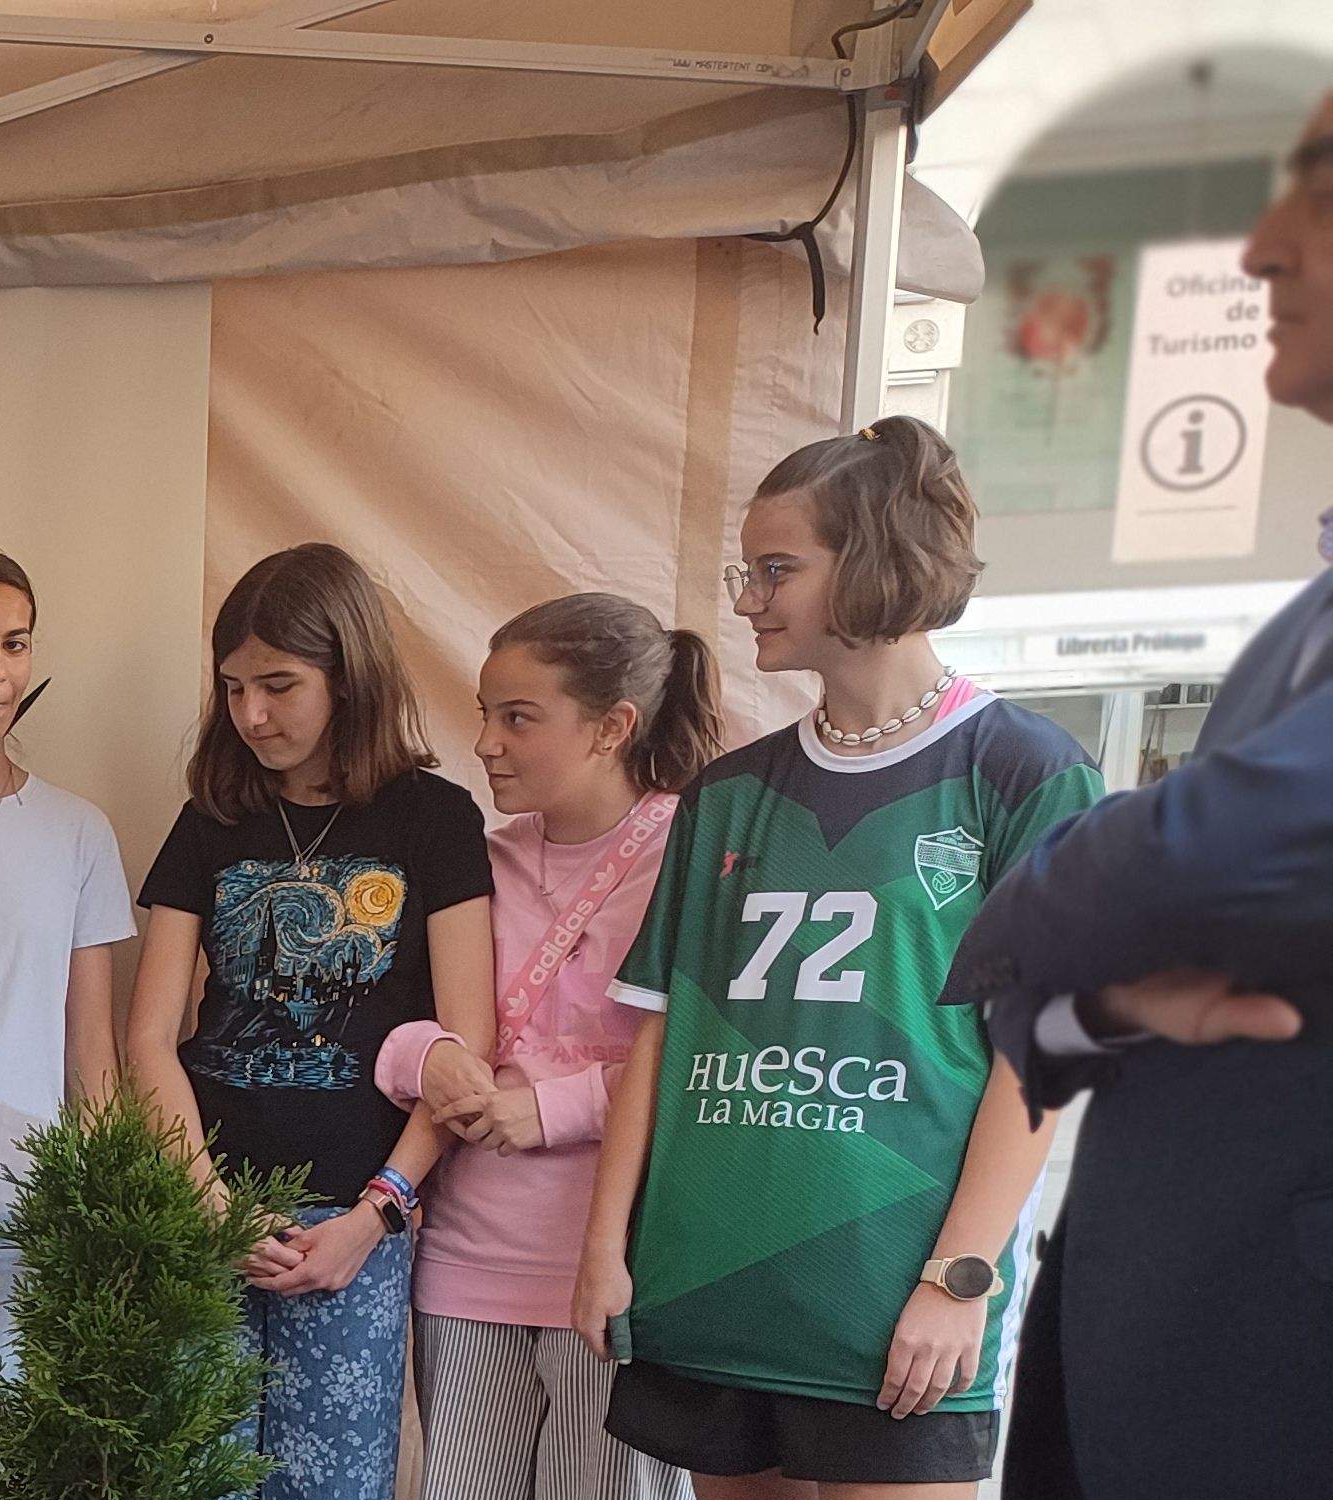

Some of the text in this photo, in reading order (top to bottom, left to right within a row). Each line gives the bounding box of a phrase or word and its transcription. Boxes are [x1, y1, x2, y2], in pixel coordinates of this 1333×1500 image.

[1166, 272, 1261, 299] Oficina
[1226, 300, 1260, 322] de
[1148, 332, 1257, 355] Turismo
[529, 899, 594, 986] adidas
[726, 890, 878, 1003] 72
